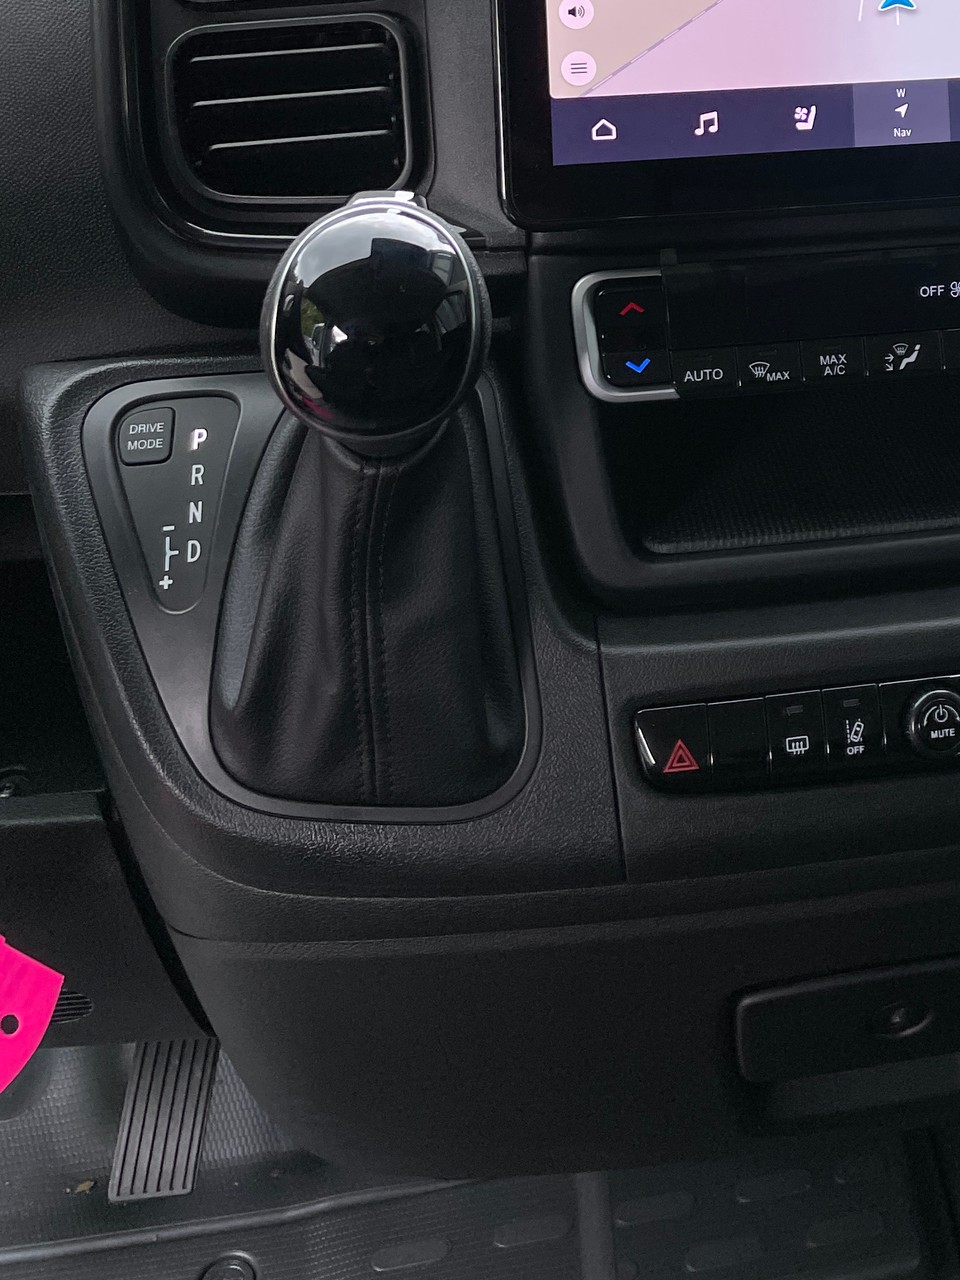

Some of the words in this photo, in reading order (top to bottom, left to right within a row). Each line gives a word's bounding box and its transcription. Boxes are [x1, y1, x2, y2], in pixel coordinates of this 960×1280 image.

[896, 88, 906, 98] W
[893, 127, 912, 137] Nav
[919, 285, 945, 297] OFF
[819, 354, 848, 366] MAX
[684, 368, 724, 383] AUTO
[766, 371, 790, 382] MAX
[823, 365, 846, 376] A/C
[129, 422, 165, 435] DRIVE
[127, 438, 164, 451] MODE
[192, 428, 208, 451] P
[190, 464, 205, 486] R
[188, 500, 203, 524] N
[186, 539, 201, 563] D
[930, 728, 956, 739] MUTE
[846, 745, 866, 756] OFF
